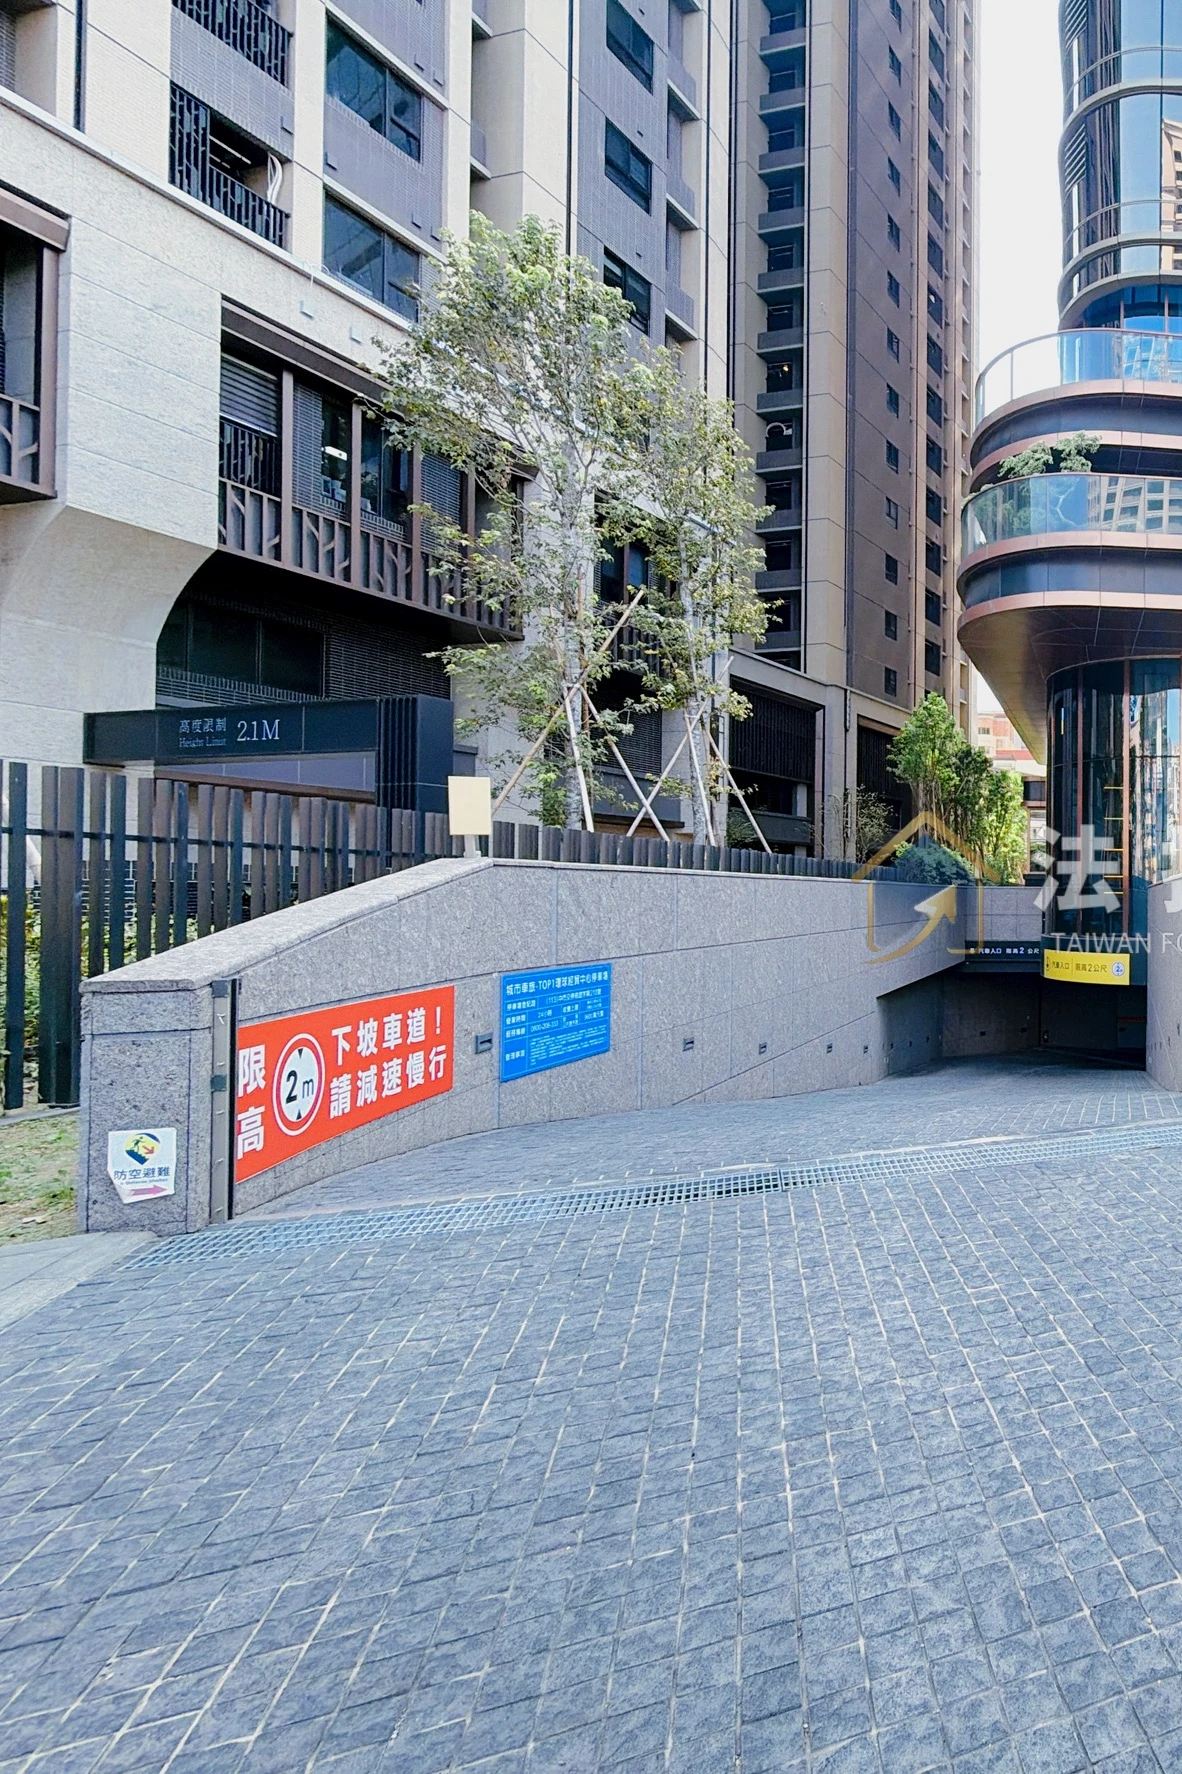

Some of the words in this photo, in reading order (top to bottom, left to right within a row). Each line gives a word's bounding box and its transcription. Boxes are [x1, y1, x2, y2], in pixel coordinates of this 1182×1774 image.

[180, 718, 227, 734] 高度限制
[329, 1044, 447, 1120] 請減速慢行
[114, 1166, 170, 1180] 防空避難
